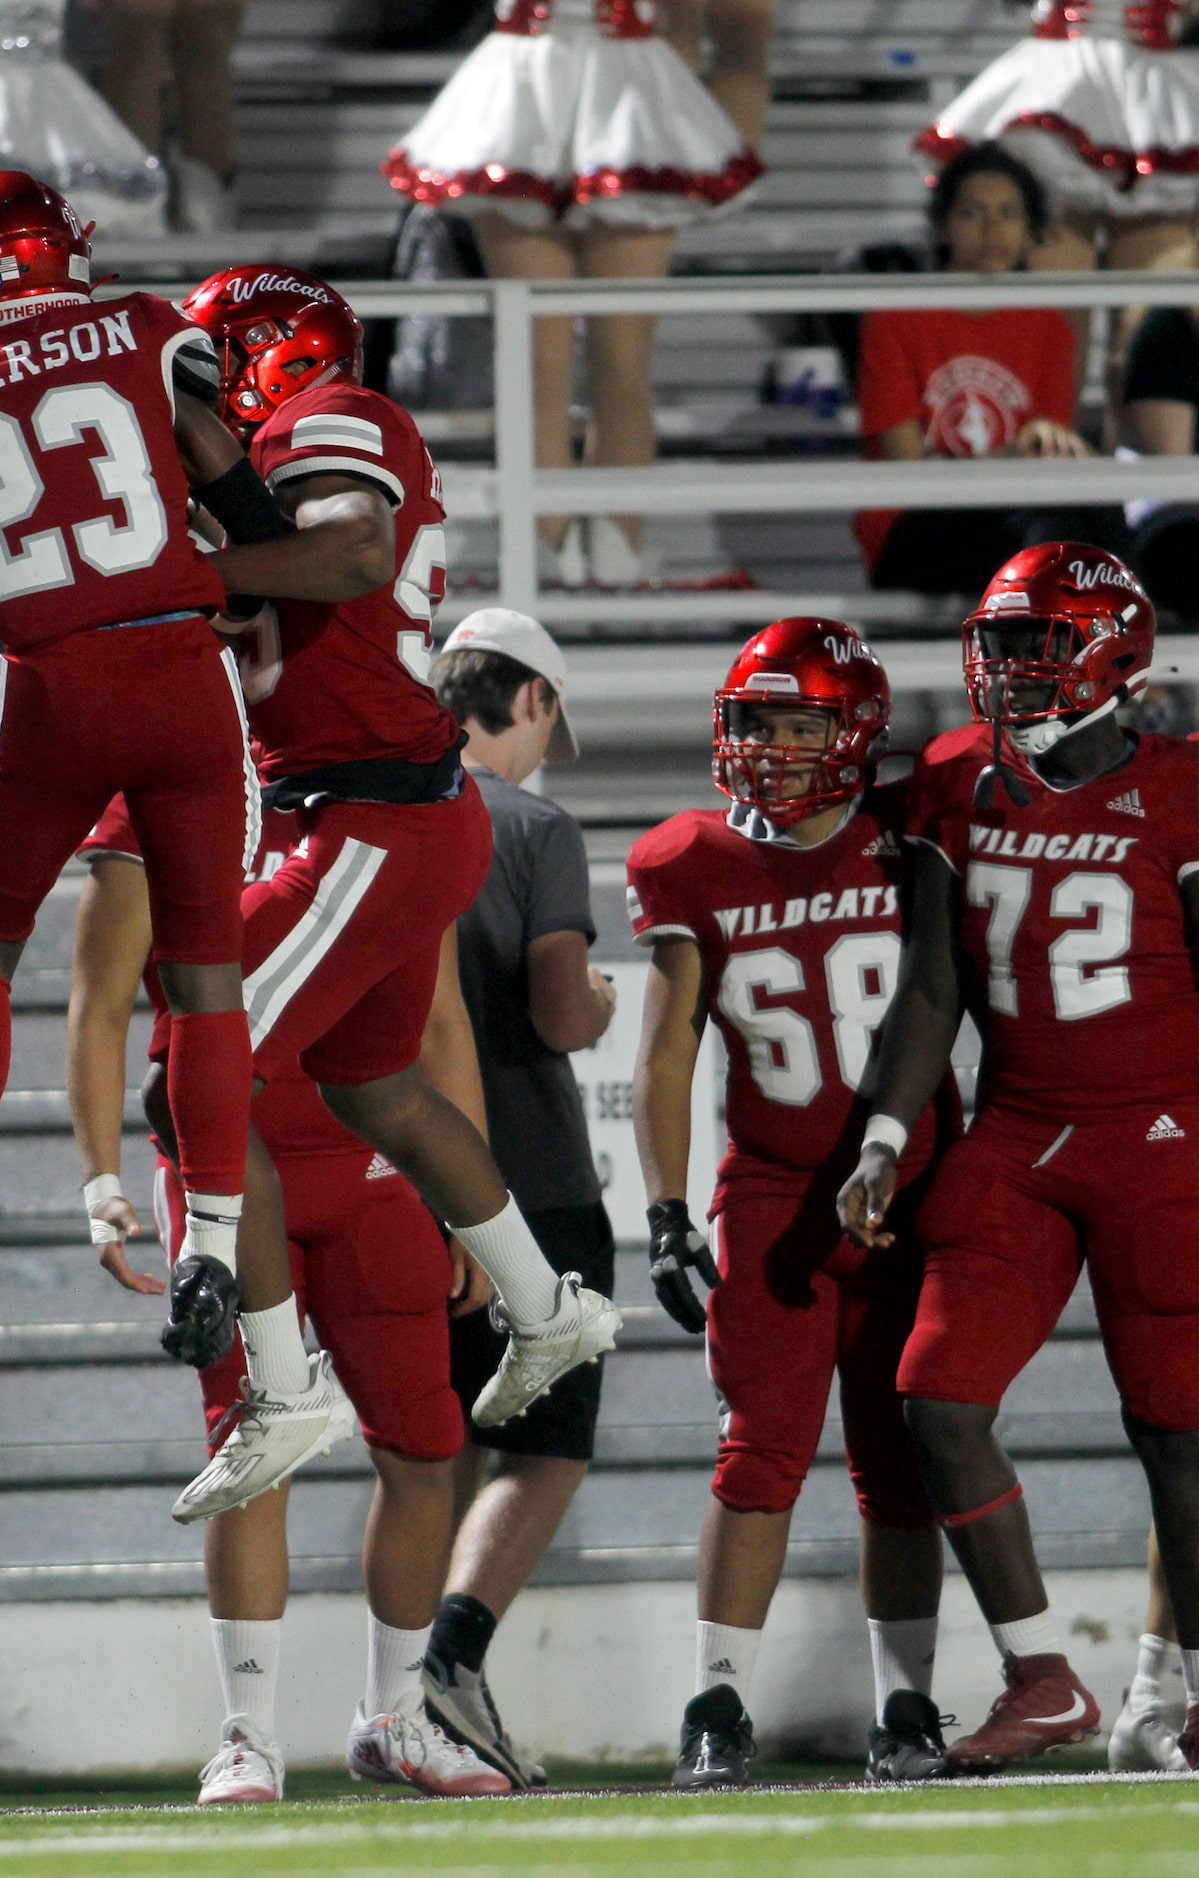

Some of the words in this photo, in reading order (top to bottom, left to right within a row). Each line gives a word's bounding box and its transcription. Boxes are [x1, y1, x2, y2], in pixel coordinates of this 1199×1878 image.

[226, 273, 334, 303] Wildcats
[969, 823, 1140, 863] WILDCATS
[713, 884, 899, 942] WILDCATS
[966, 859, 1134, 1022] 72
[717, 930, 902, 1107] 68
